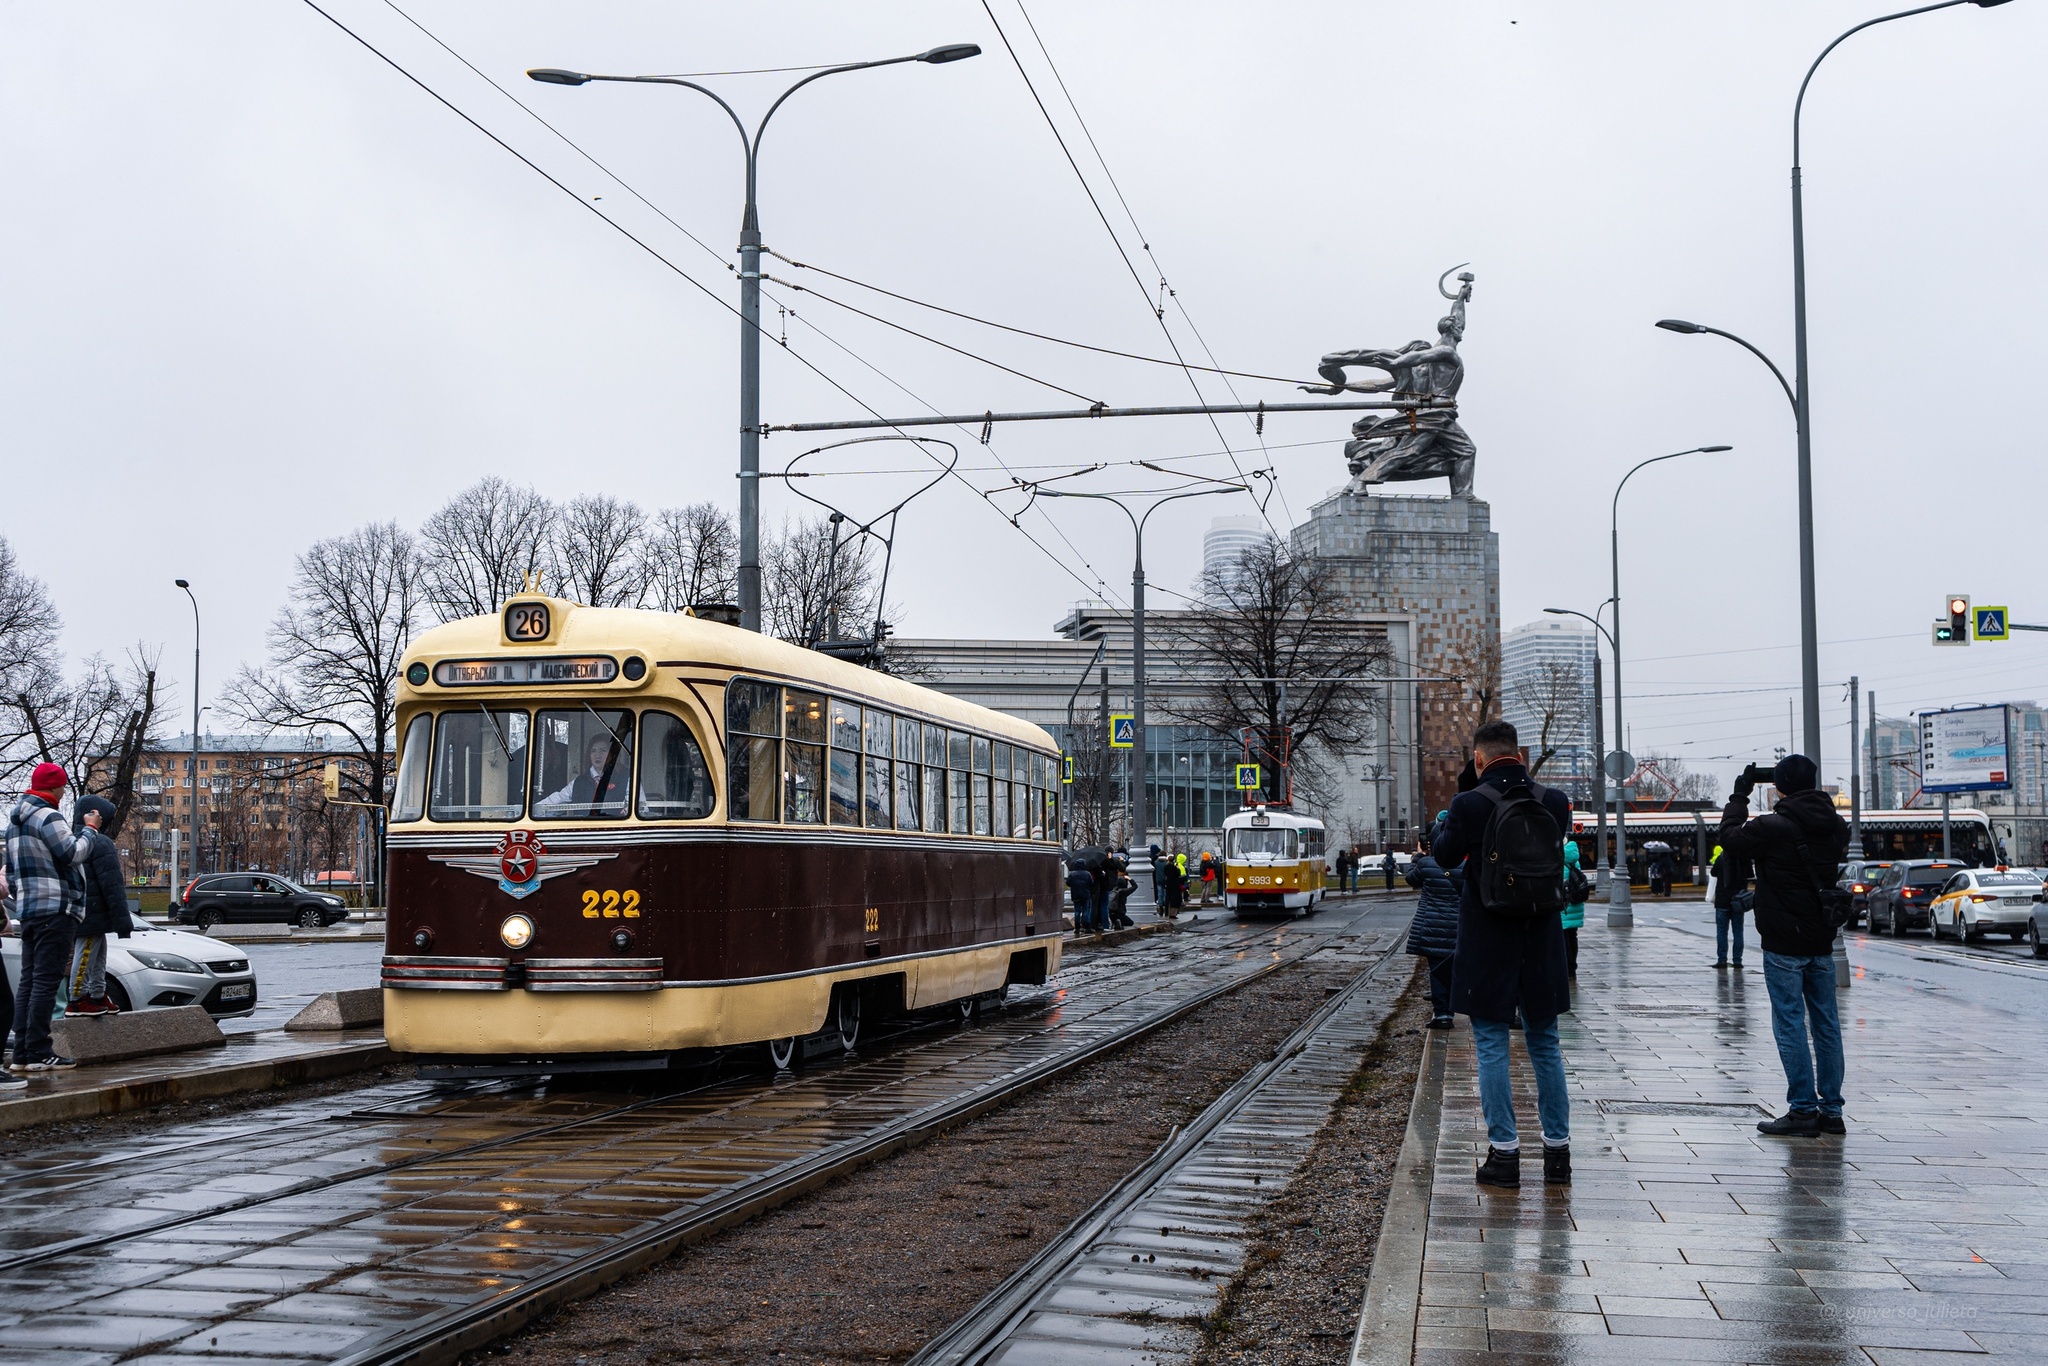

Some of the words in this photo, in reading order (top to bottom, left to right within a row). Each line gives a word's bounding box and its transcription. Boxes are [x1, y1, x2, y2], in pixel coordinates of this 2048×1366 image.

[516, 610, 544, 635] 26
[496, 830, 542, 853] РВЗ
[1249, 875, 1271, 885] 5993
[582, 889, 641, 918] 222
[865, 907, 879, 932] 222
